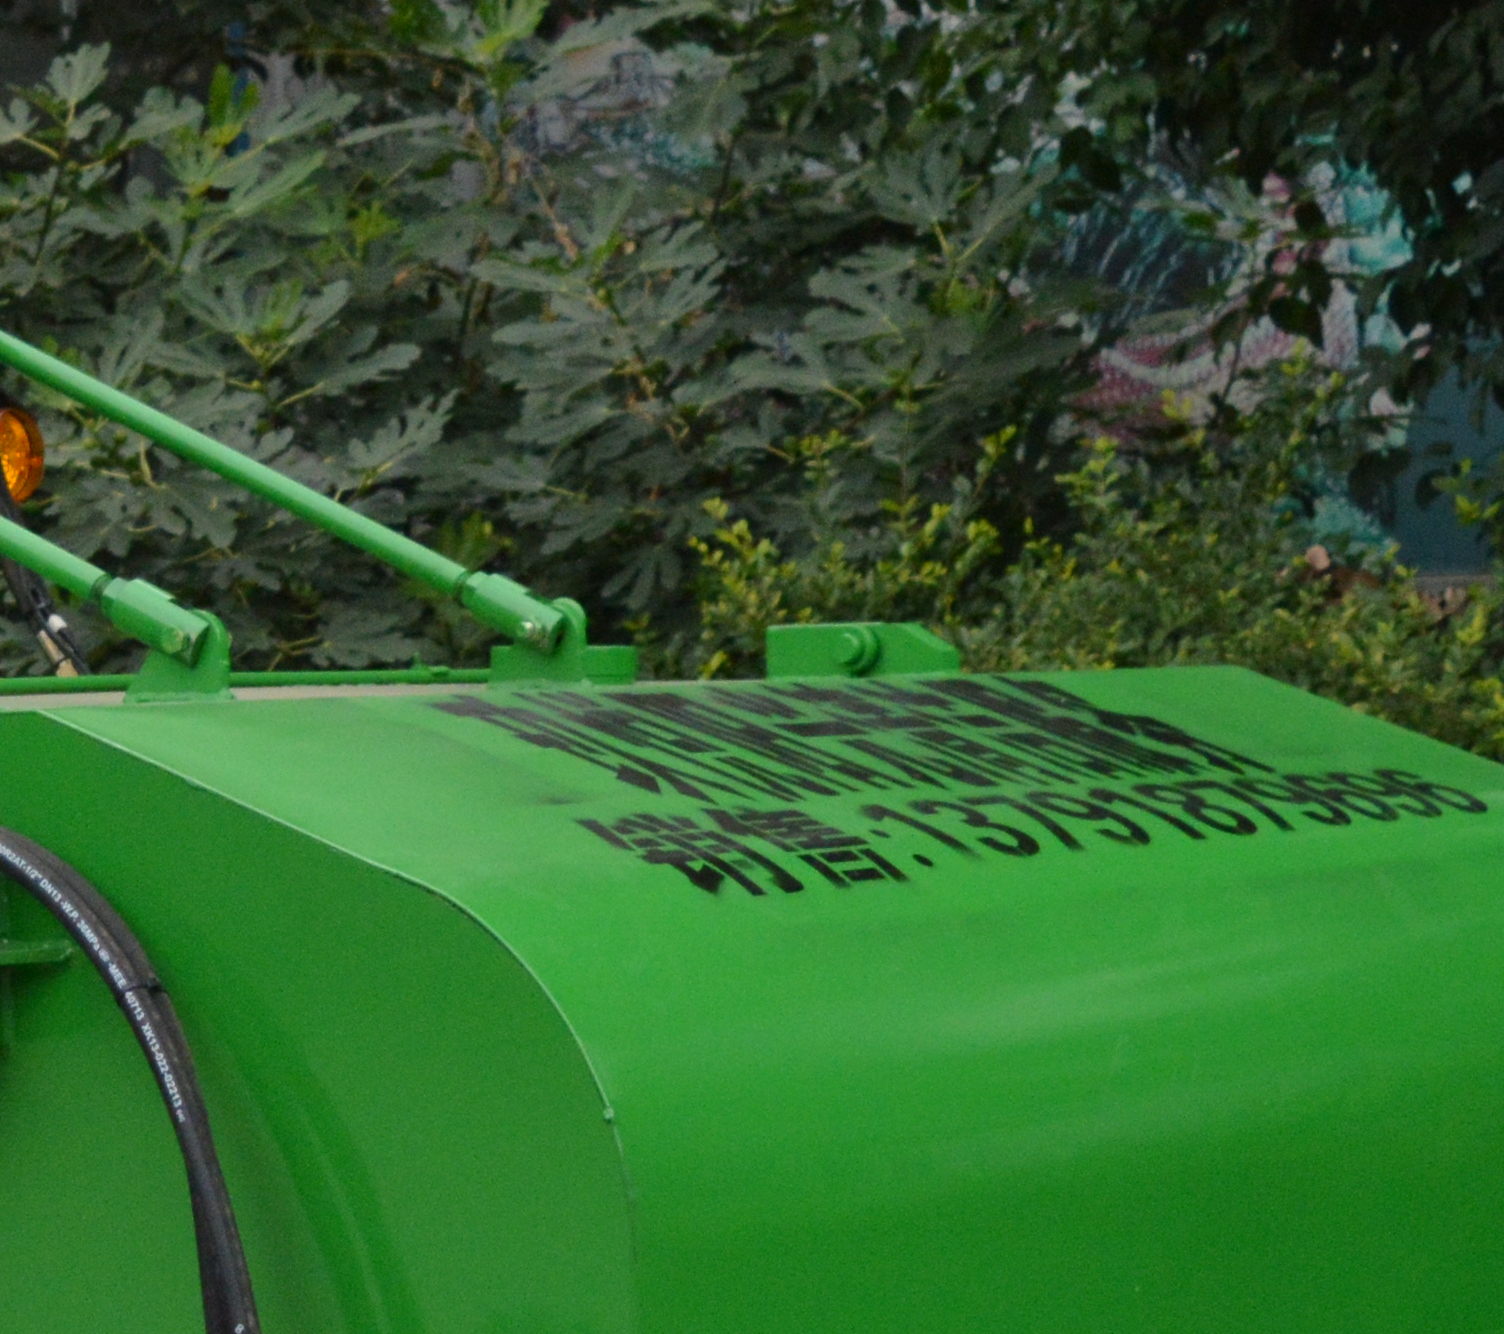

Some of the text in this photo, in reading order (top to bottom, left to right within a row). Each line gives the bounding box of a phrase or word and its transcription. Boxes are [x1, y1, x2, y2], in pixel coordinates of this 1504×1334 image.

[39, 879, 62, 903] DN13
[108, 962, 145, 1021] -MEE40713
[141, 1022, 182, 1108] XK13-022-02213
